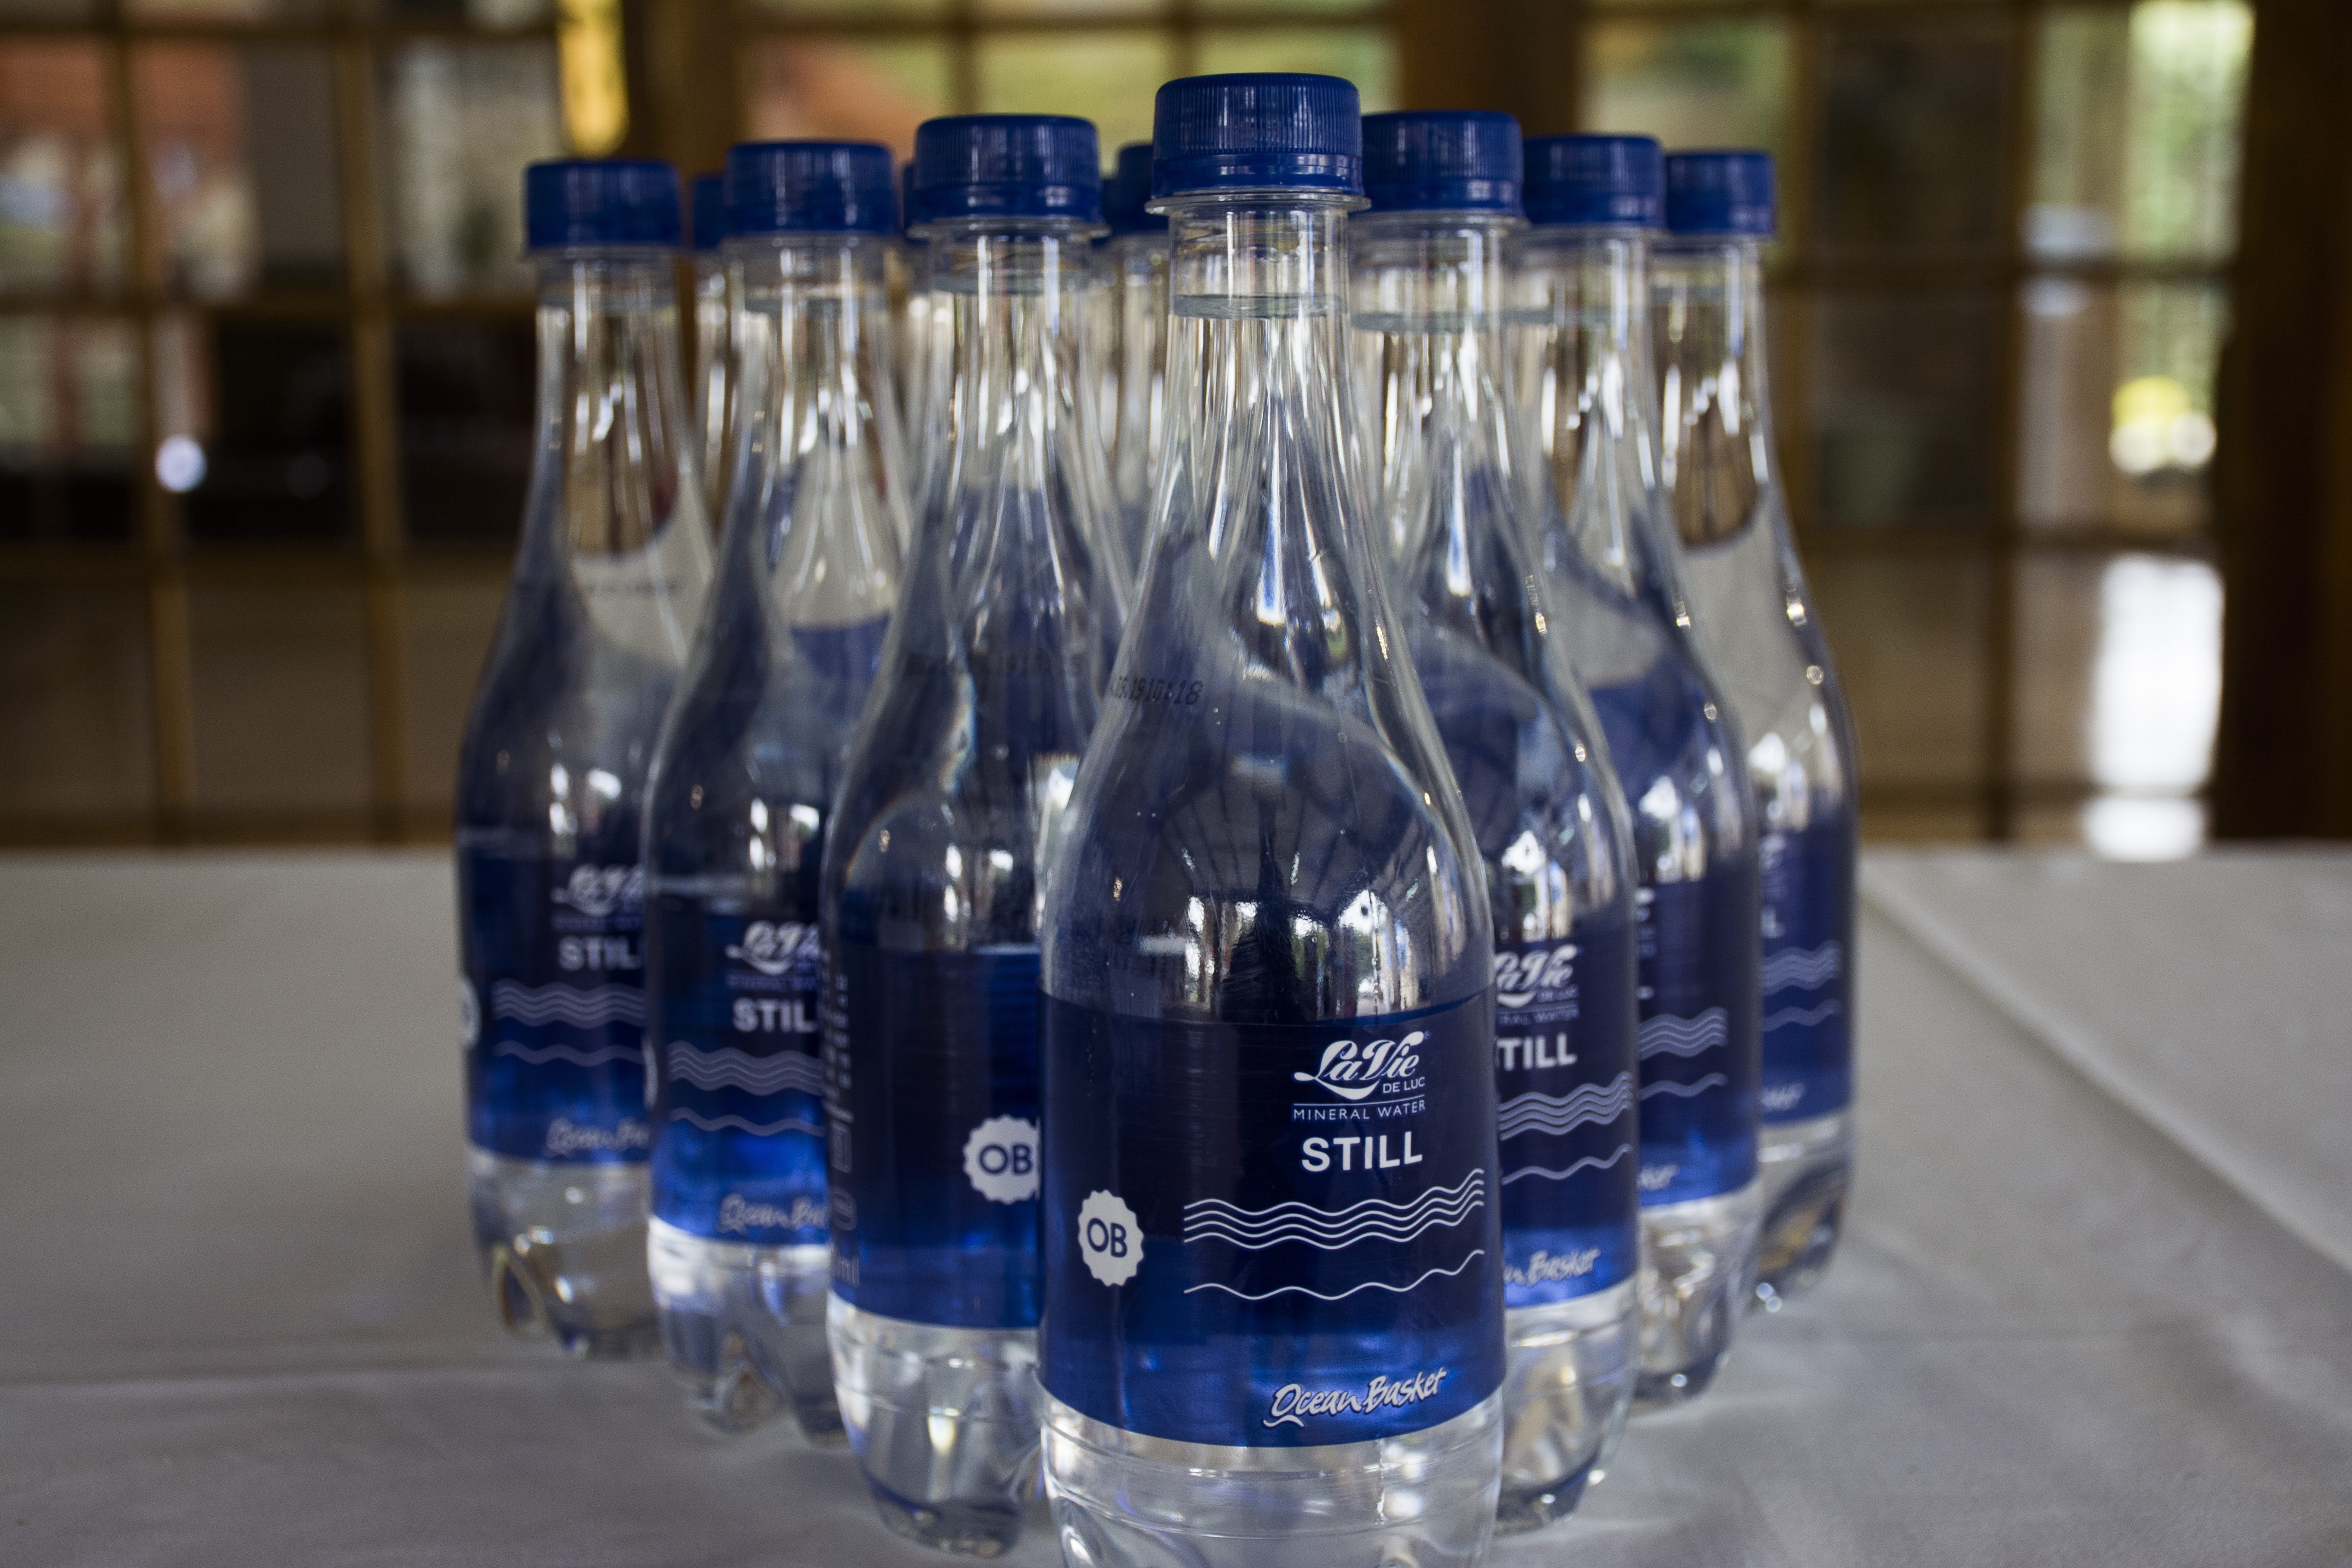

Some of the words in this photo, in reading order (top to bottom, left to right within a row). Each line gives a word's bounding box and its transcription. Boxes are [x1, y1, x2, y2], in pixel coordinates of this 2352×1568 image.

[559, 936, 643, 970] STIL
[732, 998, 818, 1033] STIL
[1496, 1033, 1578, 1072] TILL
[1383, 1083, 1400, 1094] DE
[1404, 1076, 1426, 1091] LUC
[1294, 1109, 1370, 1120] MINERAL
[1377, 1100, 1426, 1118] WATER
[979, 1144, 1033, 1175] OB
[1302, 1131, 1423, 1172] STILL
[1087, 1218, 1128, 1258] OB
[1263, 1383, 1362, 1427] Ocean
[1362, 1367, 1448, 1414] Basket
